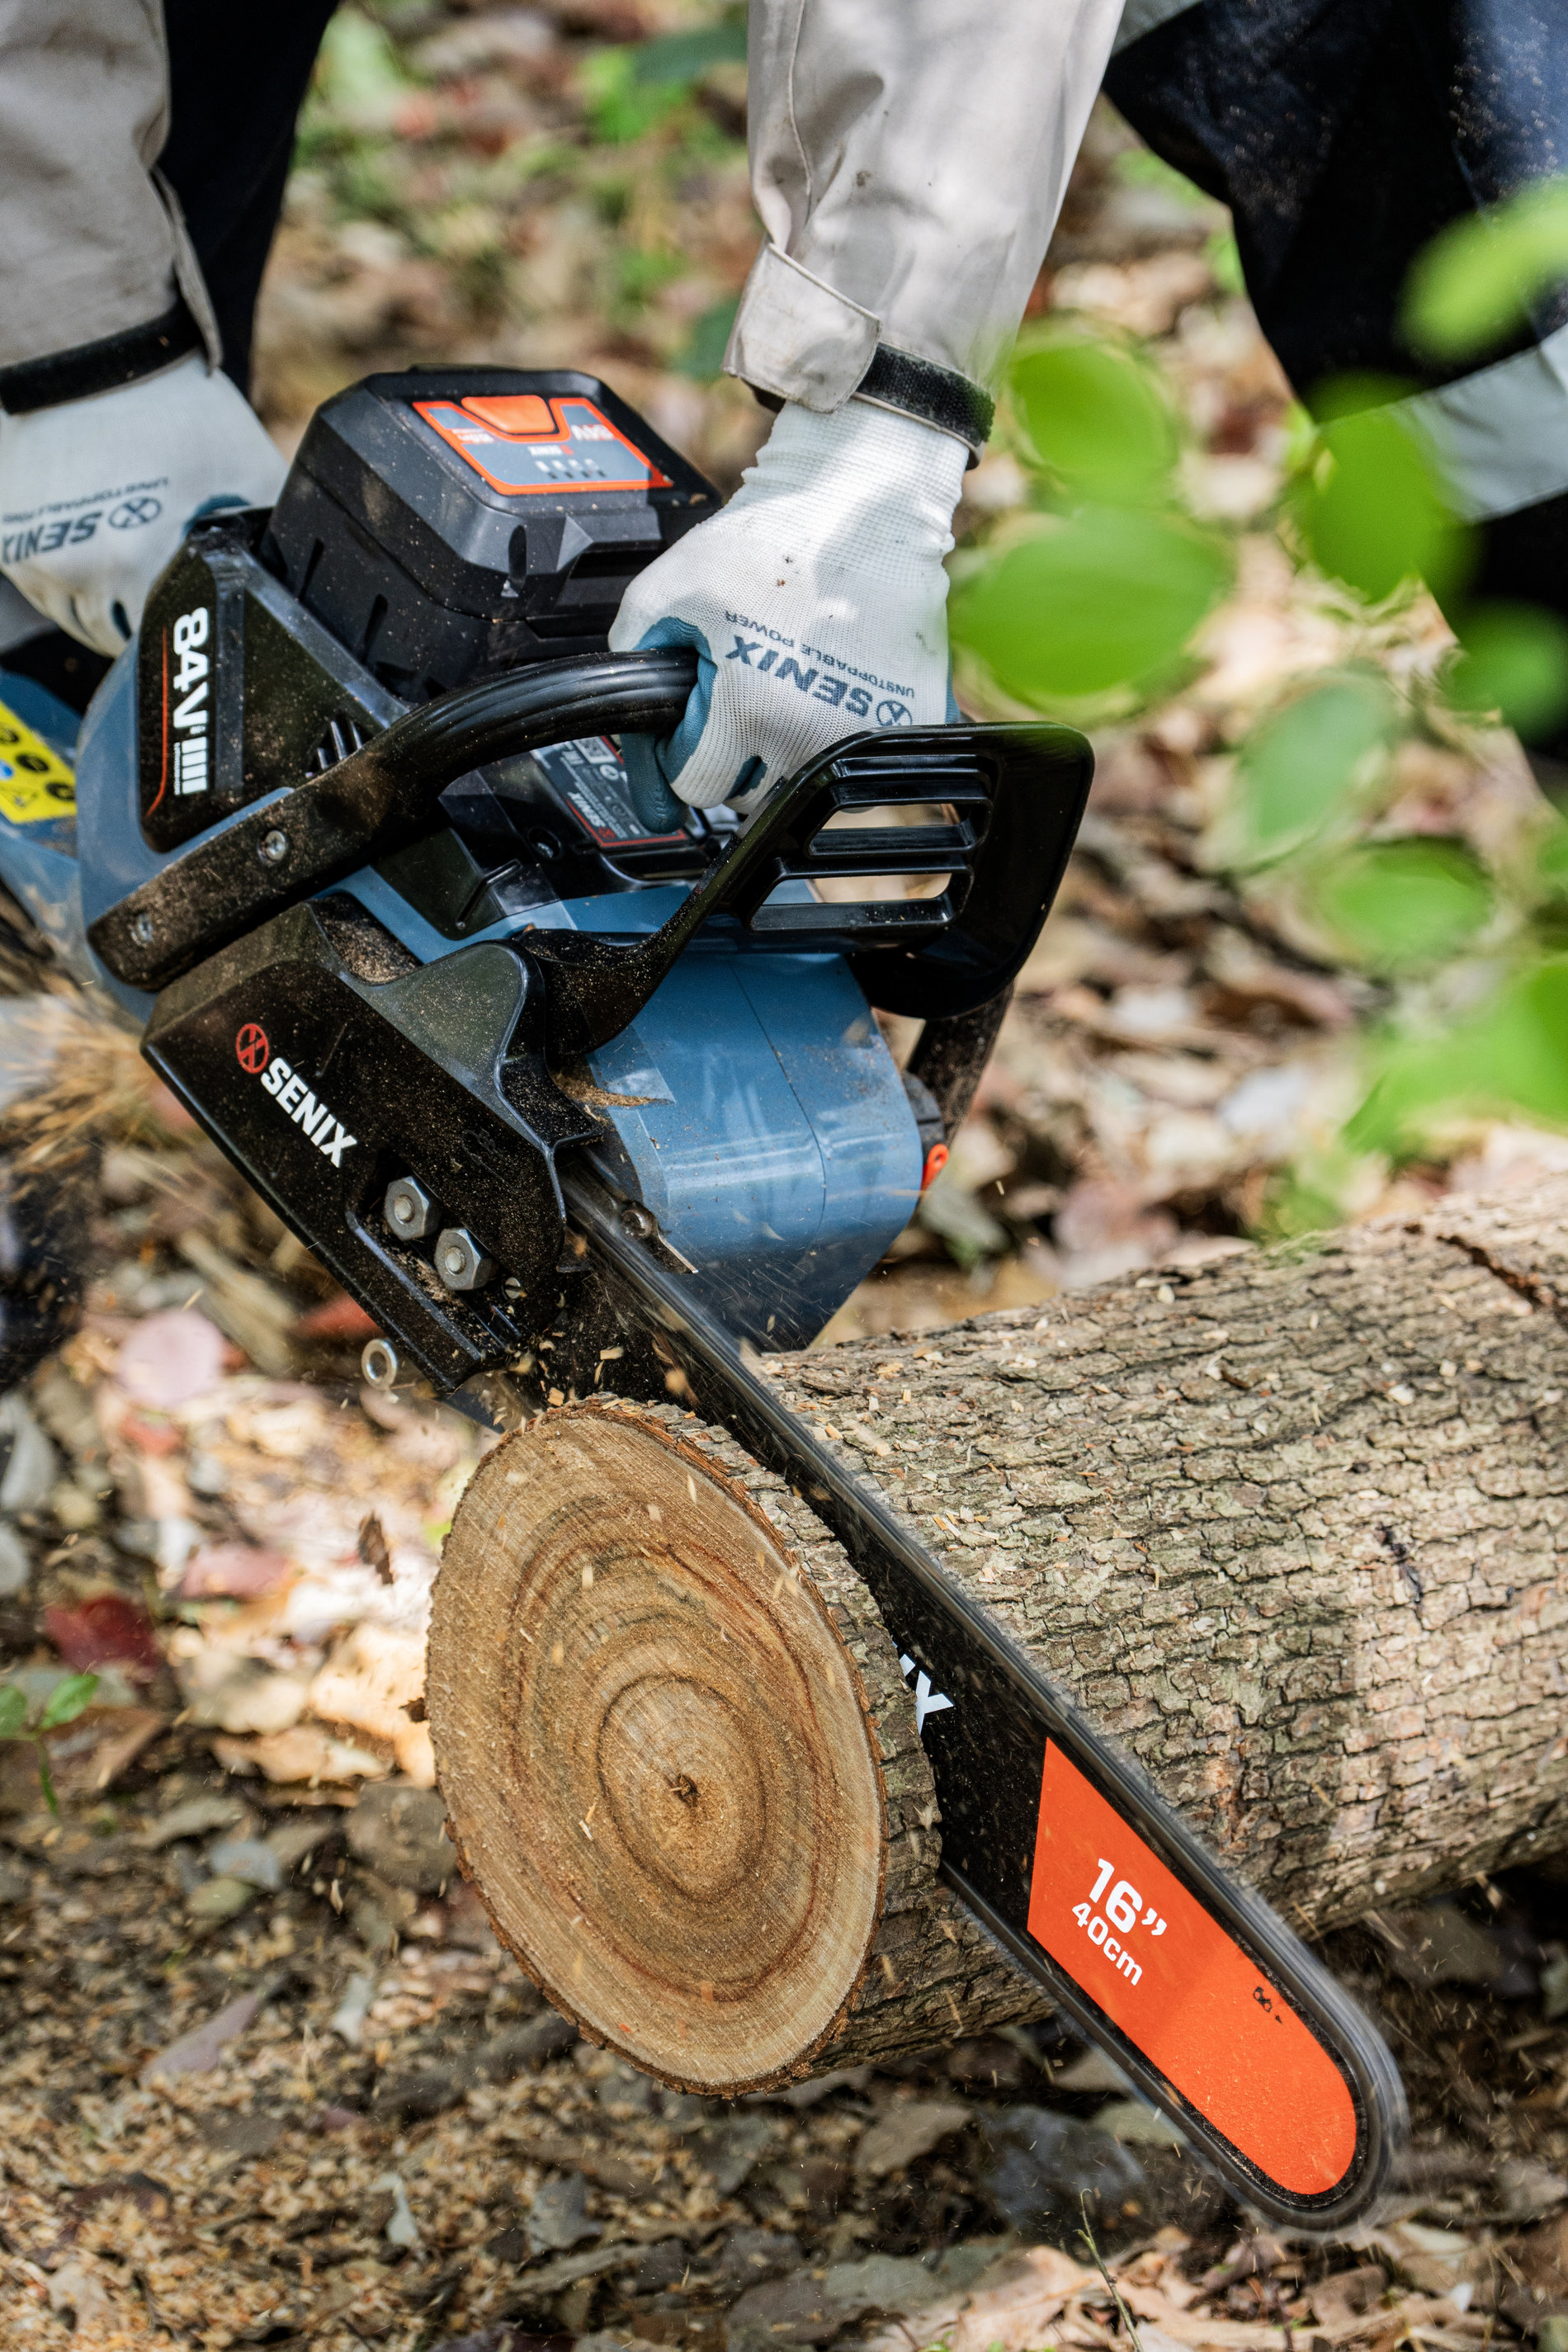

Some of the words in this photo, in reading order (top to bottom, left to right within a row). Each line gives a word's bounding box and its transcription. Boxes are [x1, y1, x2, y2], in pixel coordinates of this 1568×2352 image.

[173, 607, 209, 728] 84V
[725, 609, 795, 648] POWER
[725, 635, 873, 717] SENIX
[801, 643, 914, 699] UNSTOPPABLE
[260, 1057, 357, 1169] SENIX
[1071, 1902, 1143, 1986] 40cm
